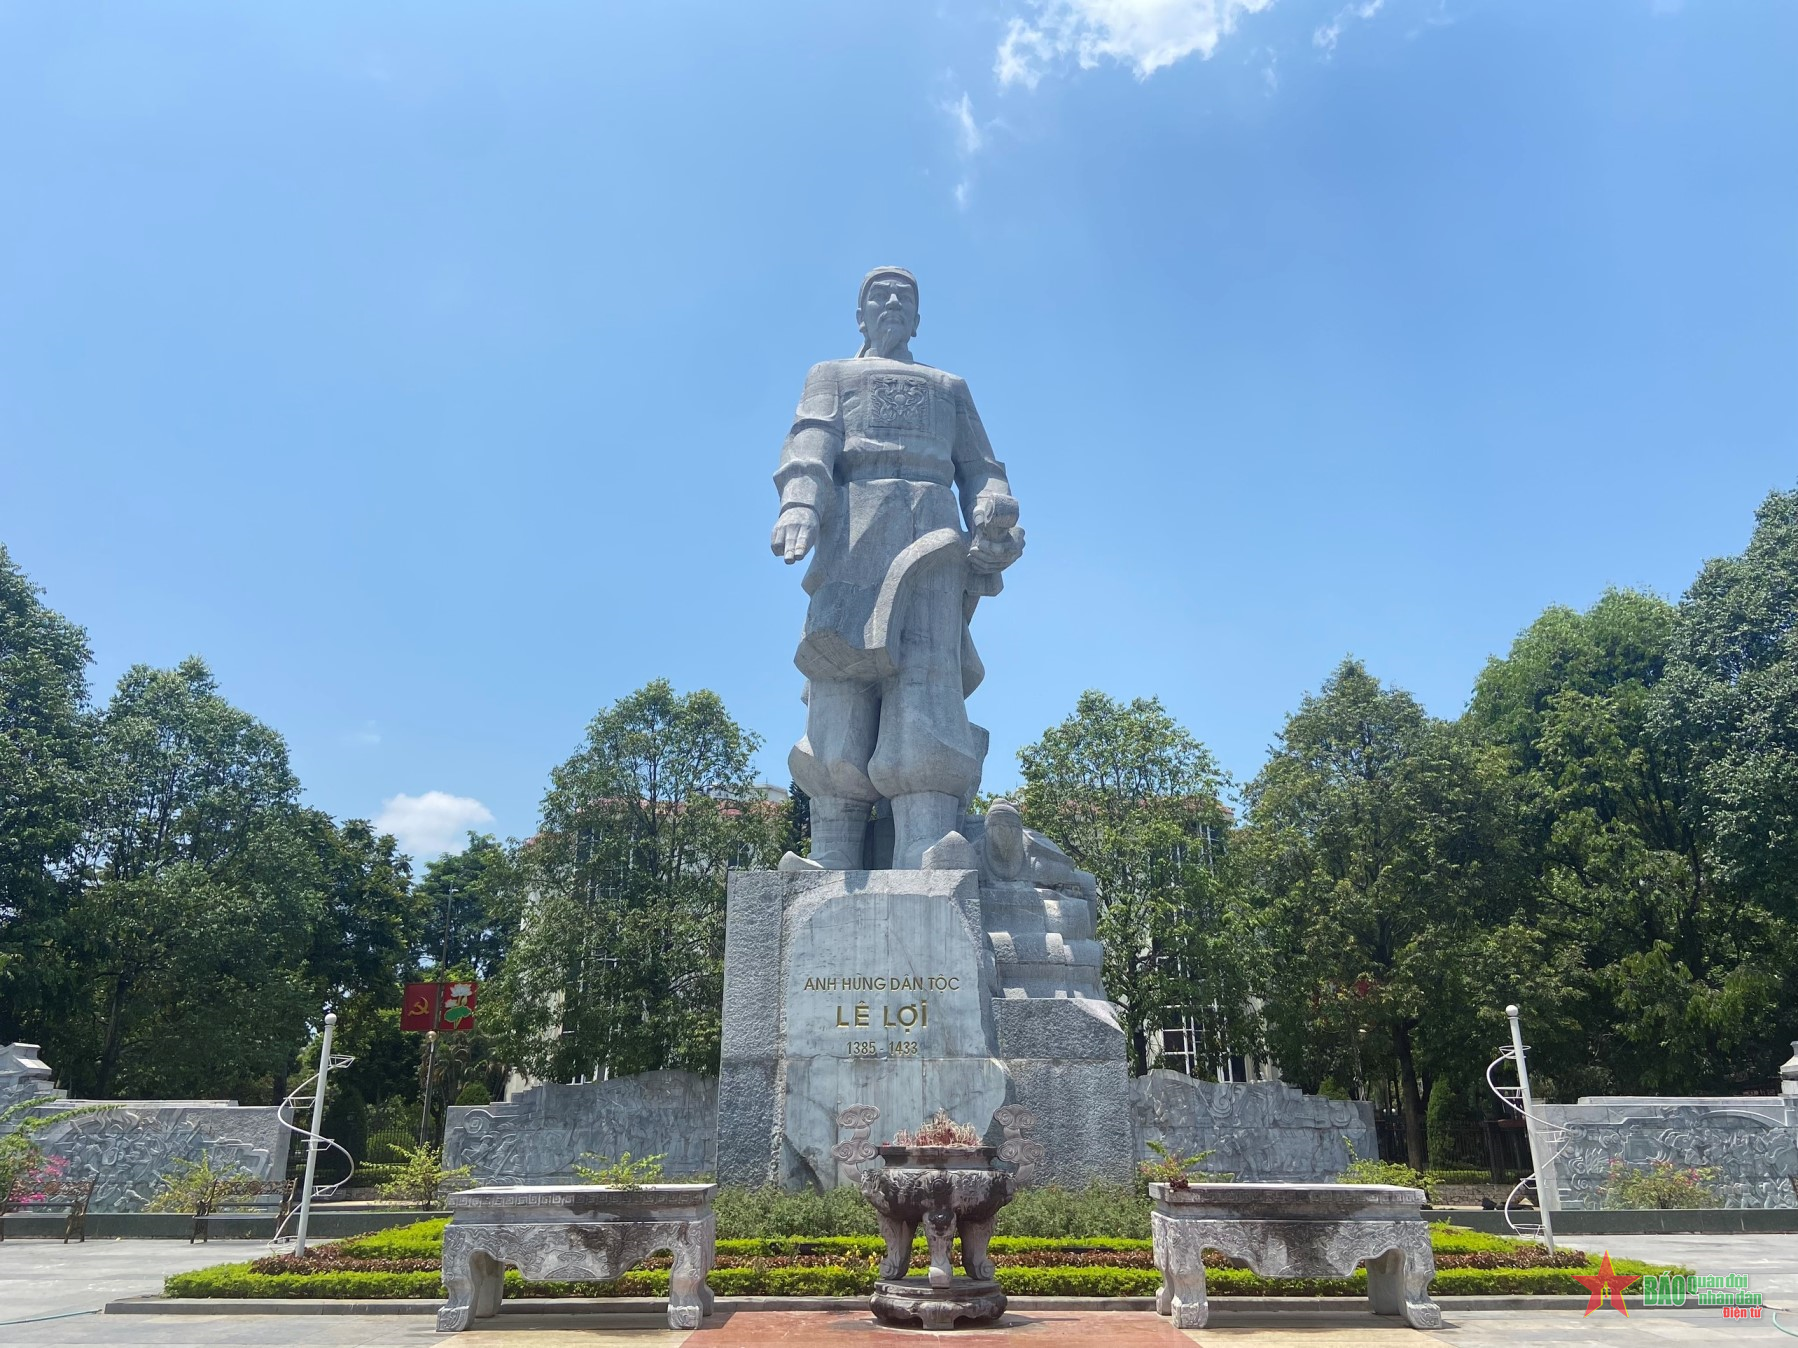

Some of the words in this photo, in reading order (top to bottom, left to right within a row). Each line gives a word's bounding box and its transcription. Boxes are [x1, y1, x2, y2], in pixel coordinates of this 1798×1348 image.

[804, 977, 837, 991] ANH
[842, 973, 887, 991] HÙNG
[890, 974, 923, 991] DÂN
[927, 974, 960, 994] TỘC
[836, 1000, 869, 1028] LÊ
[846, 1041, 876, 1056] 1385
[889, 1041, 918, 1056] 1433
